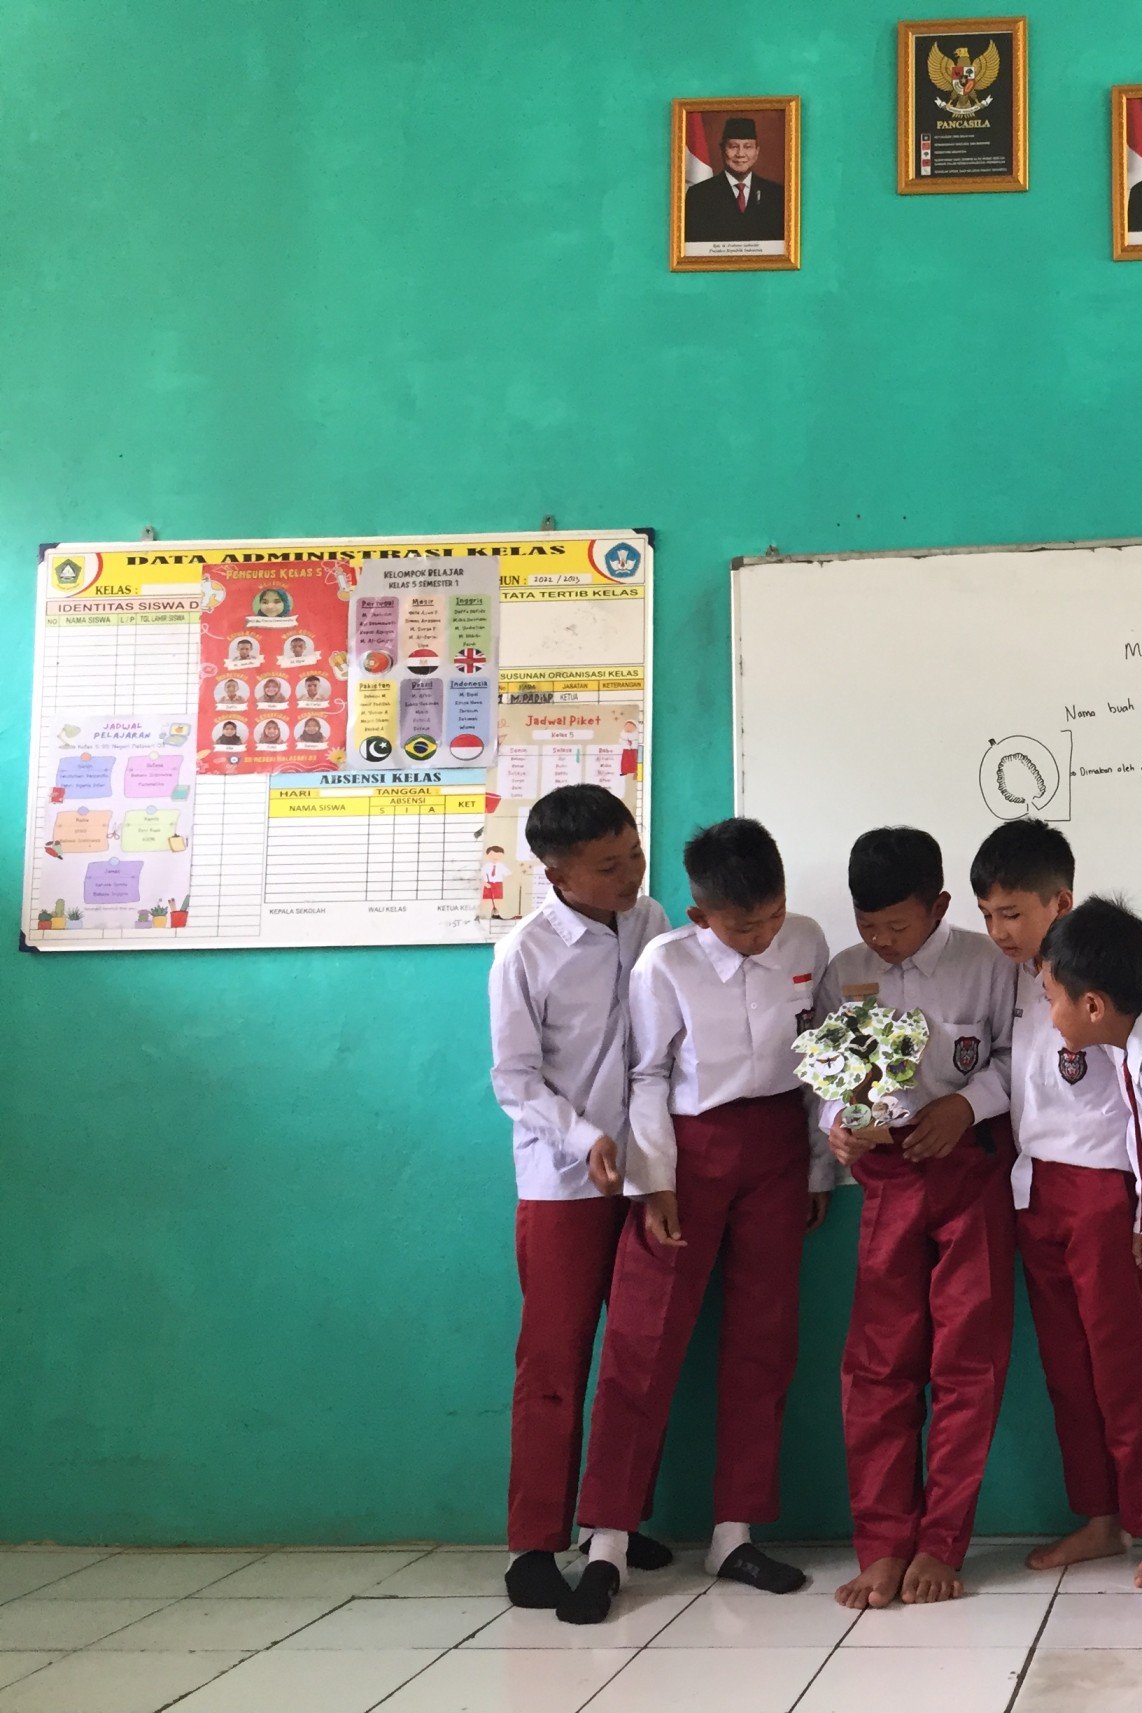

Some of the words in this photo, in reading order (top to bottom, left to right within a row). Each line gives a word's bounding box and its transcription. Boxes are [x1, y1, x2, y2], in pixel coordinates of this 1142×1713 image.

[936, 120, 991, 129] PANCASILA
[126, 555, 207, 566] DATA
[221, 549, 453, 563] ADMINISTRASI
[467, 545, 566, 557] KELAS
[383, 570, 426, 579] KELOMPOK
[428, 568, 464, 578] BELAJAR
[388, 581, 410, 589] KELAS
[418, 580, 452, 588] SEMESTER
[95, 585, 132, 596] KELAS
[539, 590, 589, 598] TERTIB
[592, 588, 639, 597] KELAS
[58, 602, 134, 613] IDENTITAS
[138, 601, 185, 611] SISWA
[500, 672, 546, 680] SUSUNAN
[548, 671, 606, 679] ORGANISASI
[608, 669, 639, 678] KELAS
[450, 680, 488, 688] Indonesia
[1108, 697, 1135, 714] buah
[526, 715, 566, 727] Jadwal
[569, 715, 601, 726] Piket
[93, 731, 151, 740] PELAJARAN
[1080, 766, 1113, 777] Dimakan
[1117, 765, 1135, 773] oleh
[319, 774, 385, 785] ABSENSI
[392, 772, 442, 783] KELAS
[279, 790, 311, 798] HARI
[376, 787, 432, 796] TANGGAL
[389, 797, 426, 805] ABSENSI
[458, 800, 476, 808] KET
